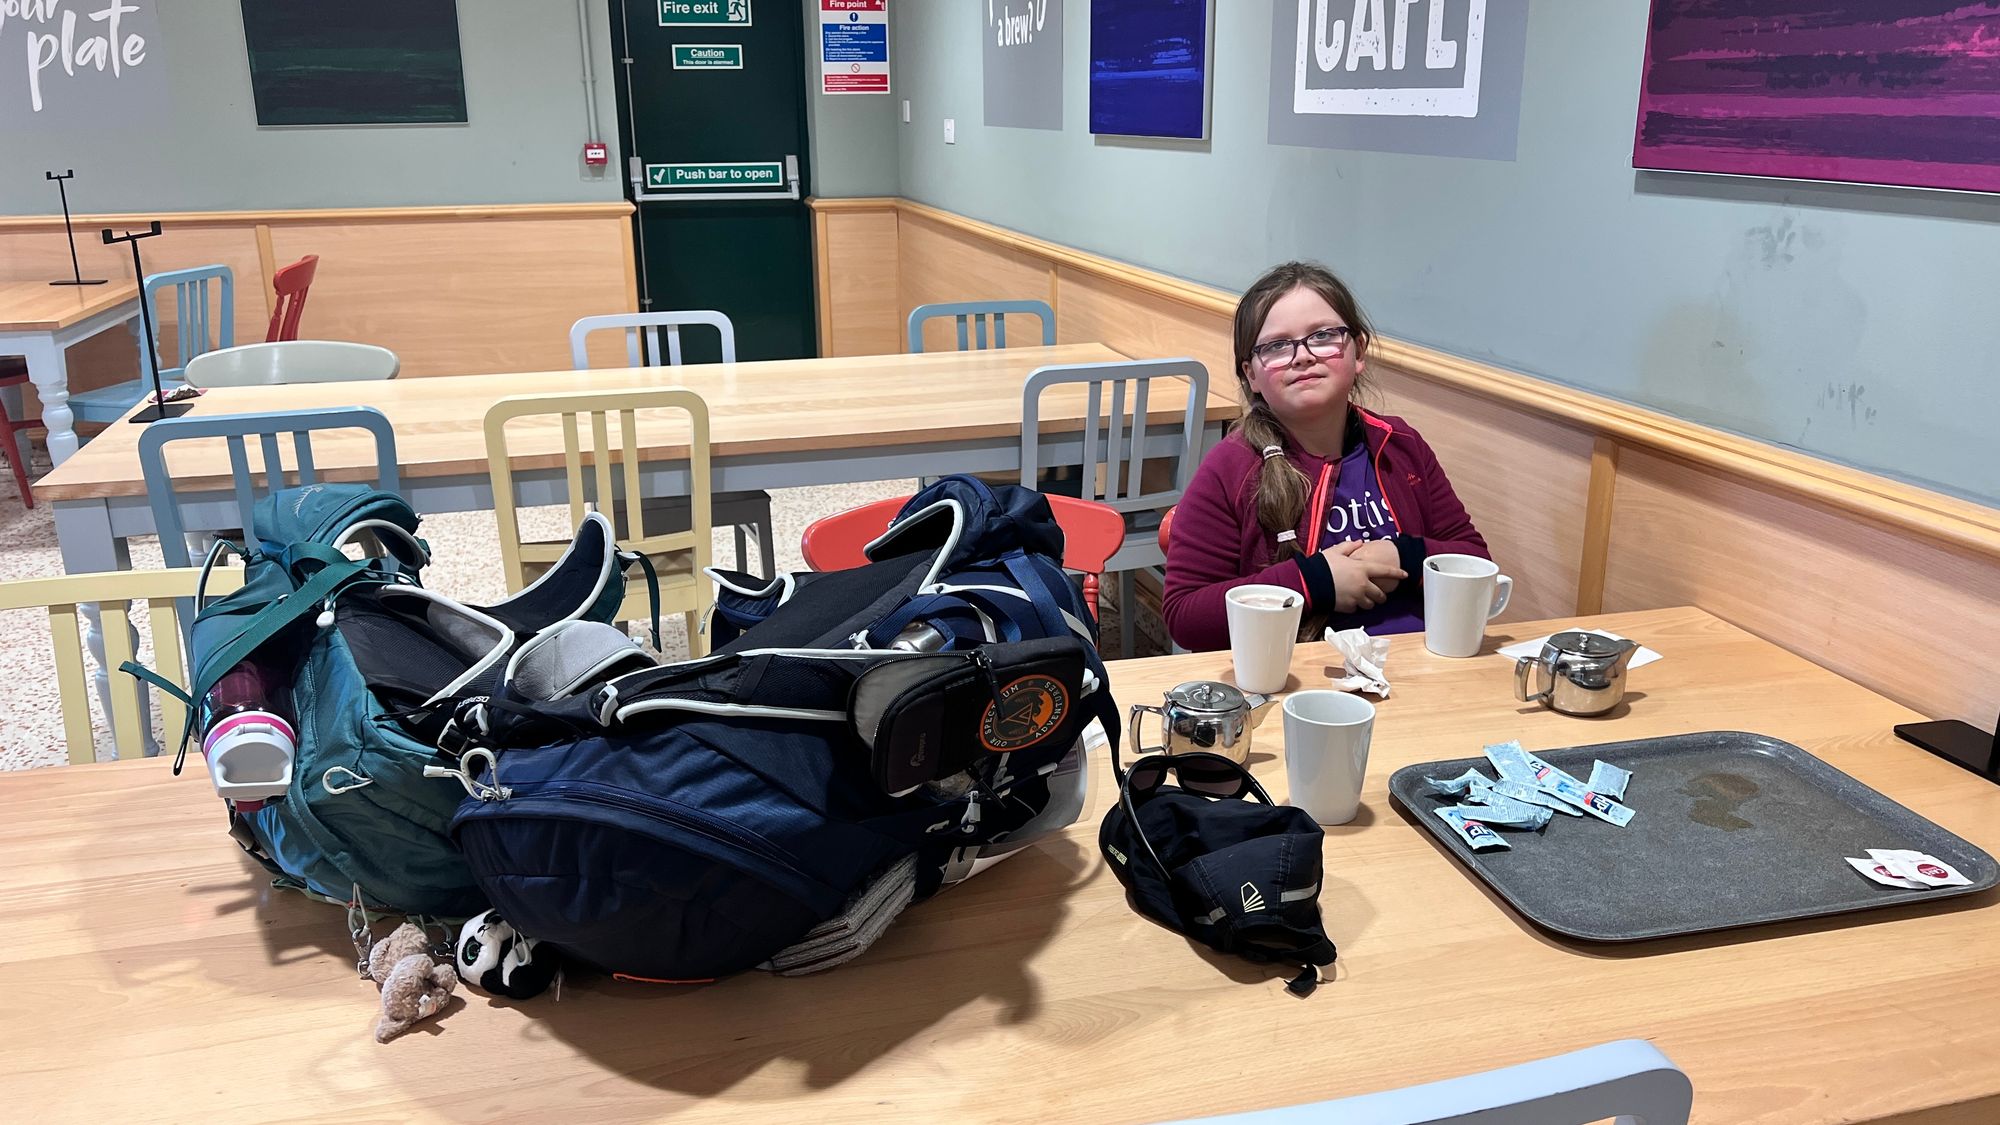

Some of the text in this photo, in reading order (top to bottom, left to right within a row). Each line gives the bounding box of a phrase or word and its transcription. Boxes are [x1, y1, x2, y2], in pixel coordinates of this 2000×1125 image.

[663, 1, 719, 14] Fire exit
[830, 0, 867, 9] Fire point
[997, 18, 1004, 47] a
[1005, 1, 1034, 46] brew?
[27, 0, 146, 112] plate
[690, 48, 725, 58] Caution
[676, 168, 773, 181] Push bar to open
[983, 681, 1063, 747] OUR SPECTUM ADVENTURES
